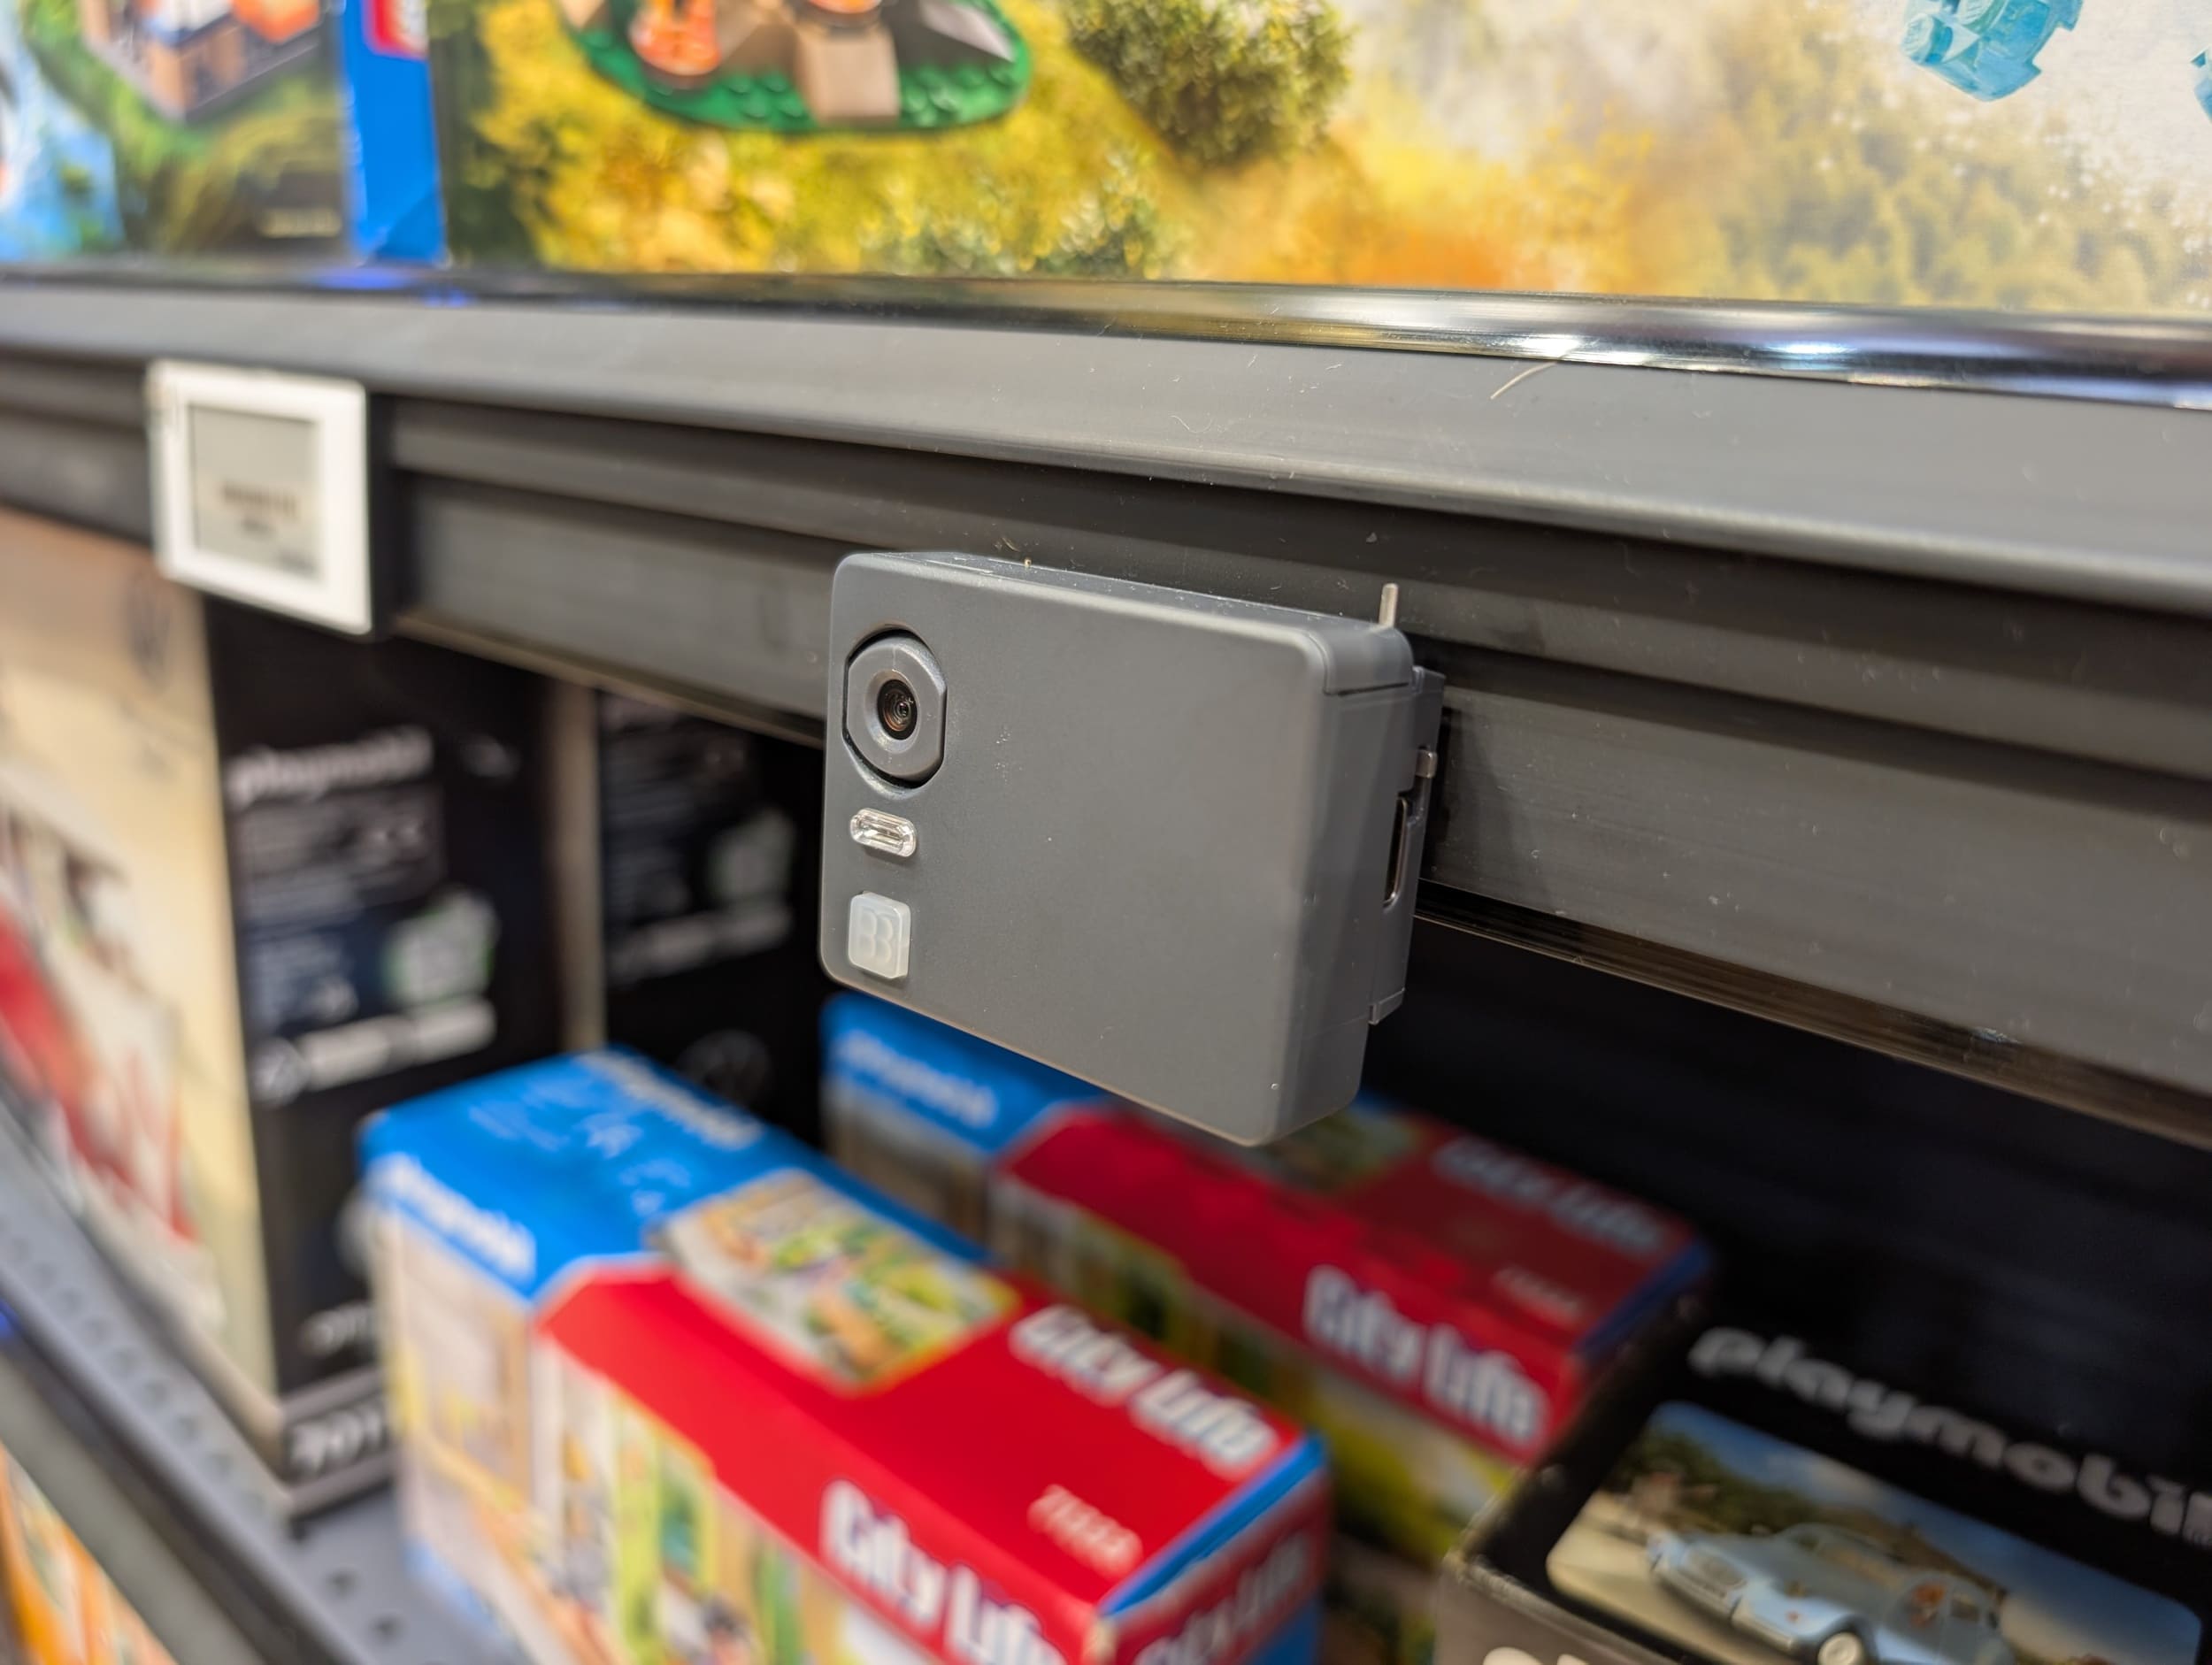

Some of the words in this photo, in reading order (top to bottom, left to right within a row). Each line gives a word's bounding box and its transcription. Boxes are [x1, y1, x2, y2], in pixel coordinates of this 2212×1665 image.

[1304, 1263, 1425, 1384] City
[1421, 1324, 1548, 1453] Life
[819, 1478, 950, 1628] City
